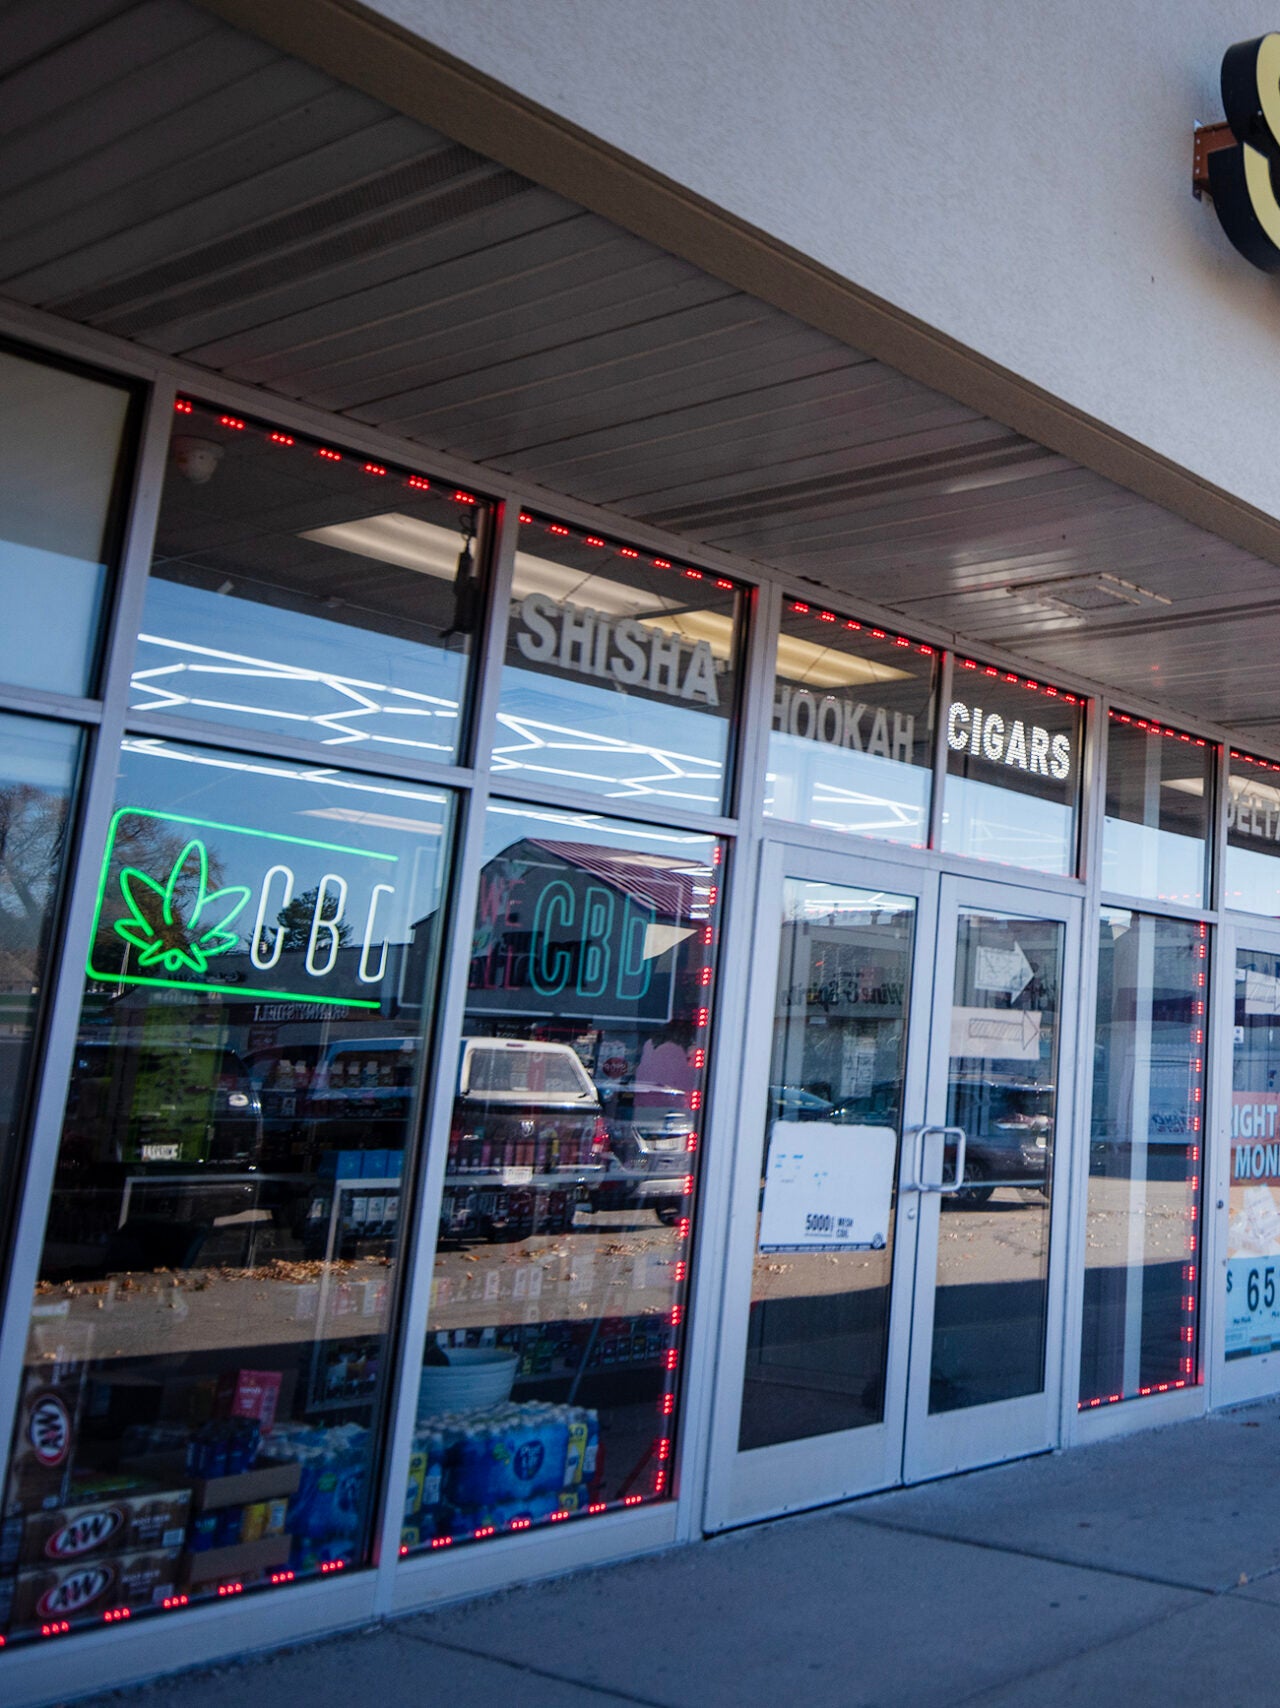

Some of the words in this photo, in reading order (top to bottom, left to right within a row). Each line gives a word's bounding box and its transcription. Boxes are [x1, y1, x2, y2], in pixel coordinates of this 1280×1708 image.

[517, 594, 720, 707] SHISHA
[771, 684, 915, 765] HOOKAH
[946, 702, 1071, 780] CIGARS
[529, 880, 657, 1000] CBD
[1232, 1104, 1278, 1138] IGHT
